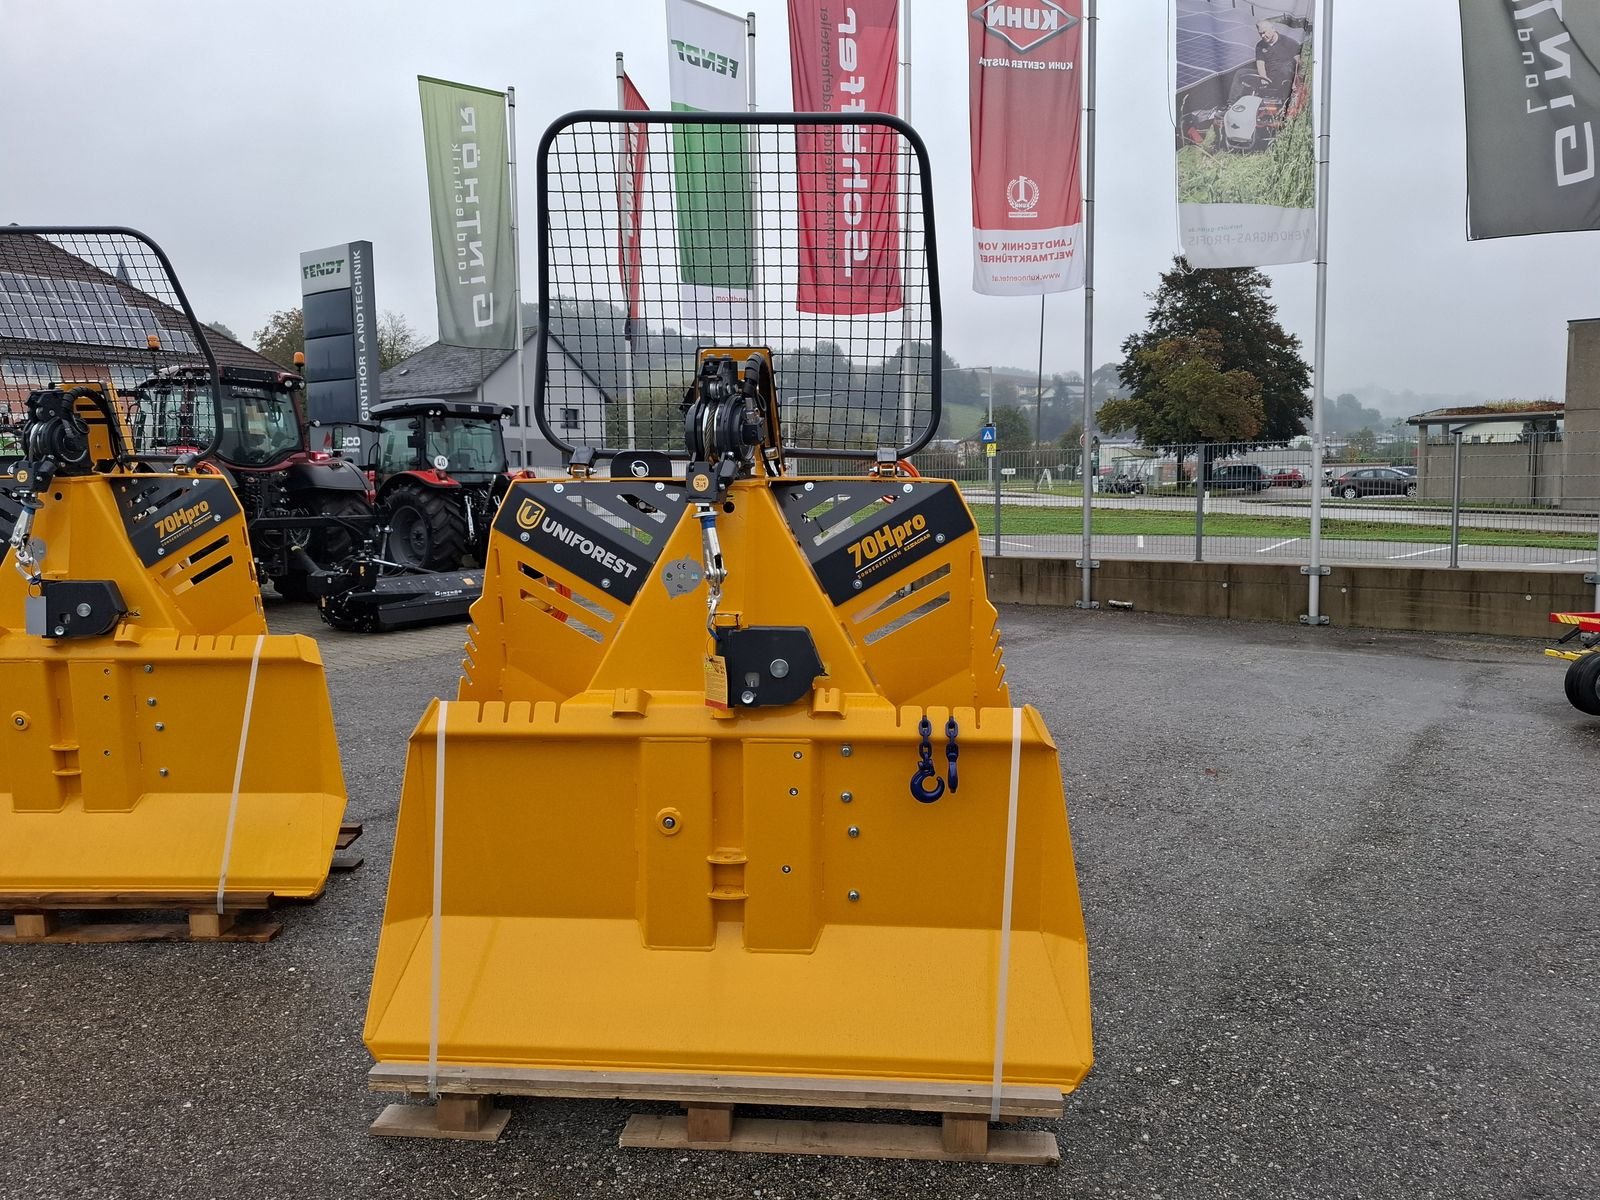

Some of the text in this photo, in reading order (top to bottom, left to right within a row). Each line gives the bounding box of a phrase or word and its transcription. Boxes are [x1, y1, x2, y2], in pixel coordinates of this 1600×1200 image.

[302, 259, 345, 279] FENDT
[353, 250, 369, 421] GINTHÖR LANDTECHNIK
[154, 500, 209, 539] 70Hpro
[847, 514, 926, 568] 70Hpro
[541, 516, 638, 578] UNIFOREST
